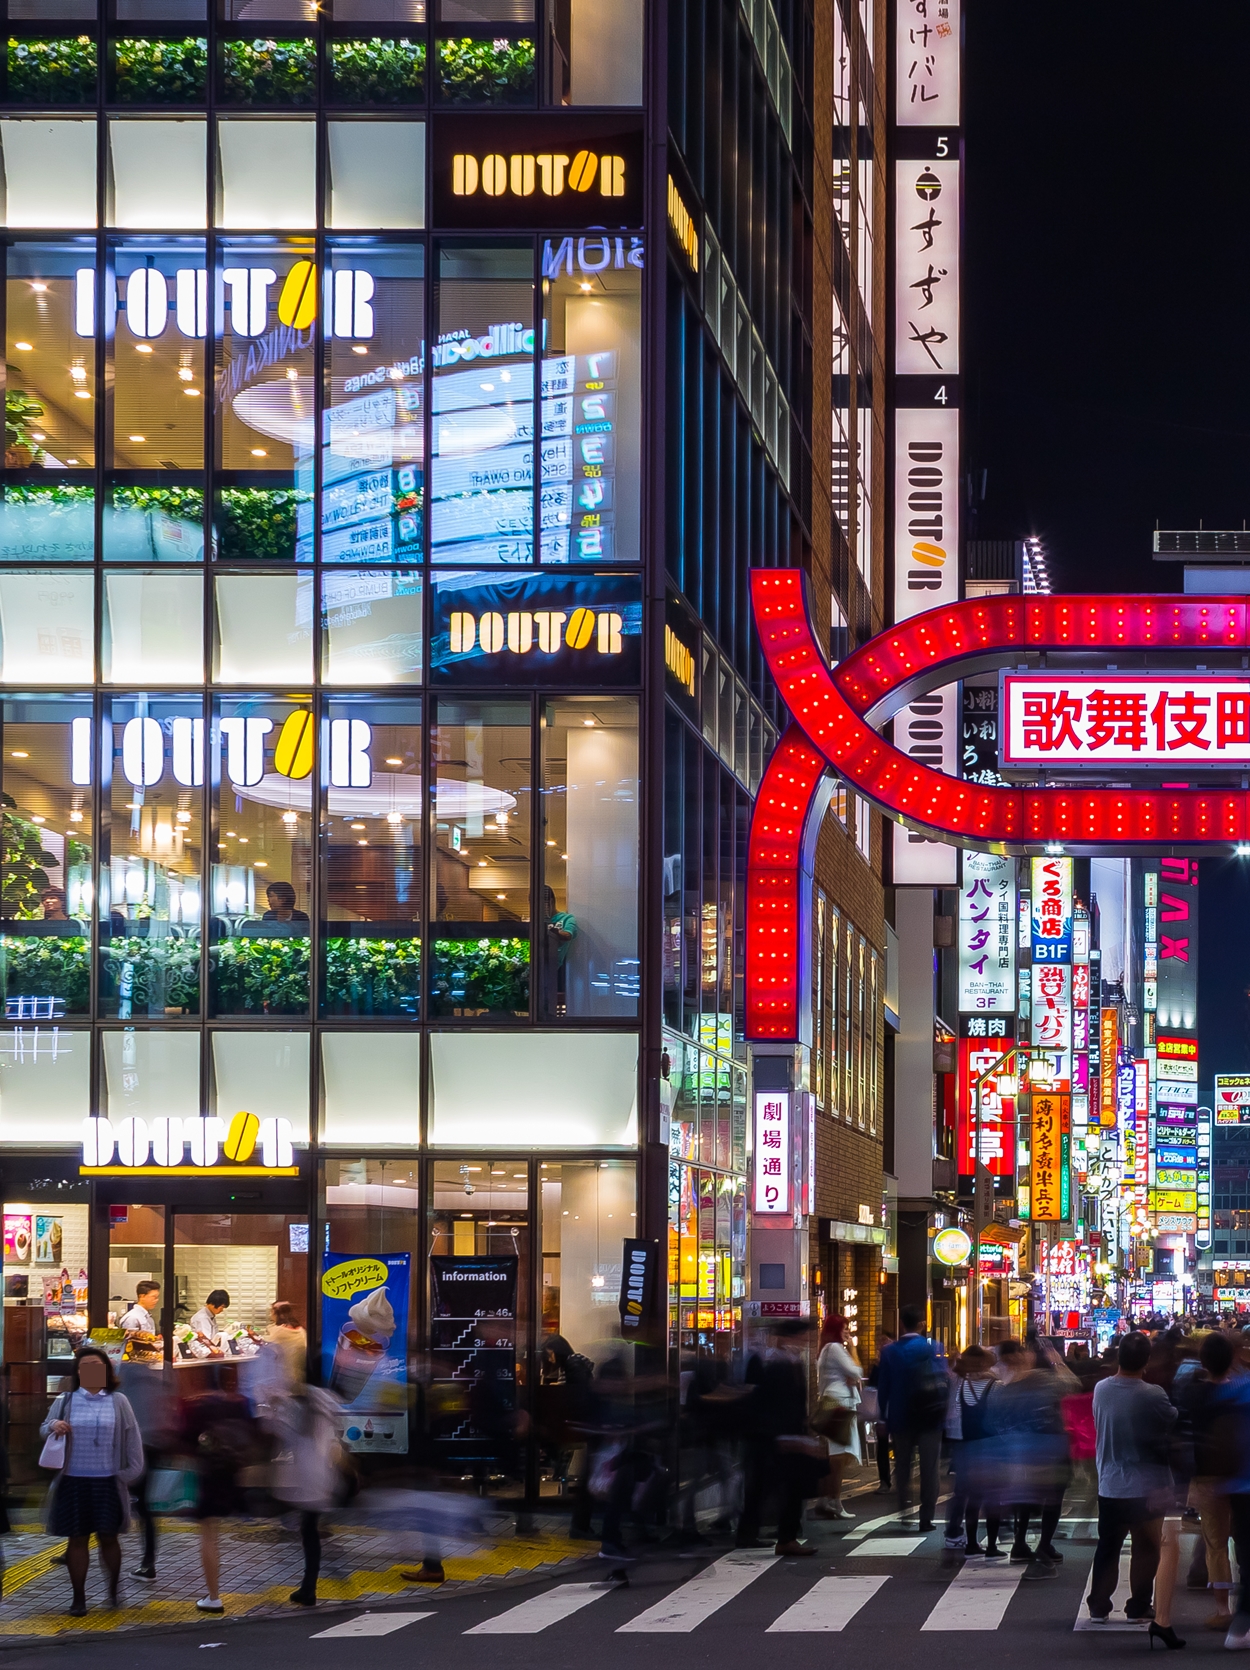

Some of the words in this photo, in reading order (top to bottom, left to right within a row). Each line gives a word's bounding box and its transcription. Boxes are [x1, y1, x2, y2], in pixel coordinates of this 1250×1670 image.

[935, 137, 949, 157] 5
[453, 150, 624, 196] DOUTOR
[908, 207, 949, 370] すずや
[934, 386, 948, 404] 4
[907, 441, 947, 591] DOUTOR
[449, 608, 622, 654] DOUTOR
[966, 878, 994, 975] バンタイ
[998, 879, 1010, 969] タイ国料理専門店
[1035, 944, 1068, 960] B1F
[976, 997, 997, 1009] 3F
[968, 1017, 1006, 1037] 焼肉
[1157, 1042, 1196, 1056] 全店営業中
[82, 1111, 294, 1168] DOUTOR
[762, 1102, 782, 1203] 劇場通り
[1157, 1197, 1182, 1209] ゲーム
[332, 1273, 384, 1296] ソフトクリーム
[442, 1271, 507, 1282] information
[623, 1251, 647, 1327] DOUTOR
[474, 1308, 486, 1317] 4F
[474, 1338, 486, 1347] 3F
